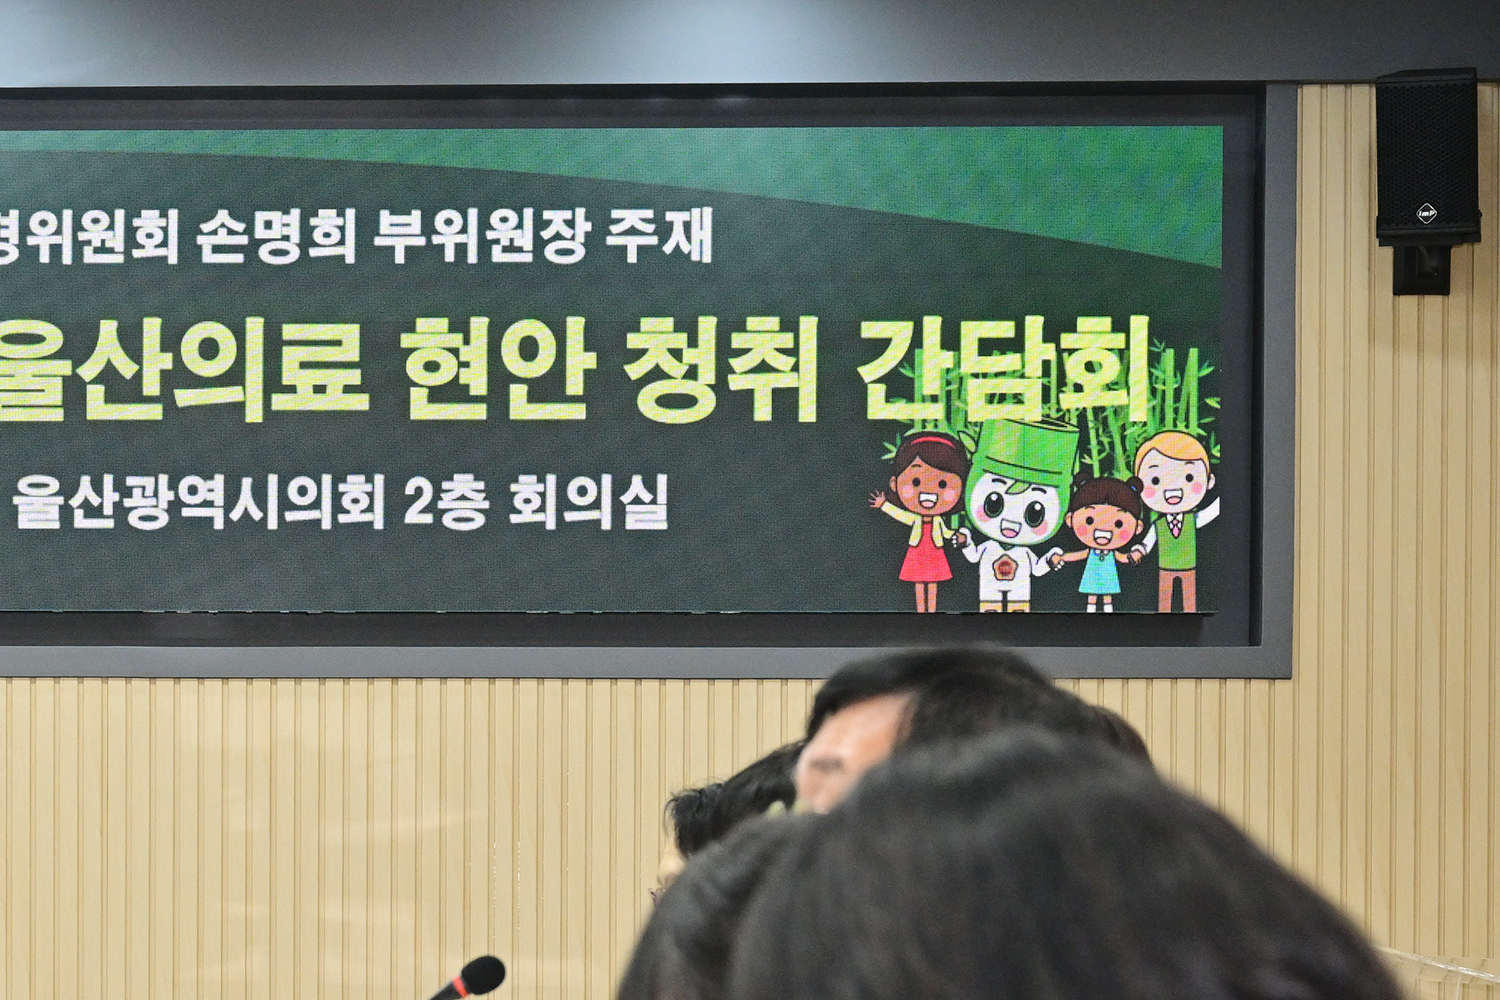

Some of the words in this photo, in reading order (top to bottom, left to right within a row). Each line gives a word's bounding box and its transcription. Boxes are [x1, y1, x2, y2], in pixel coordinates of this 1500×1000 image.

[197, 207, 356, 265] 손명희
[374, 207, 591, 265] 부위원장
[606, 206, 713, 264] 주재
[400, 316, 597, 421] 현안
[623, 315, 819, 424] 청취
[856, 315, 1152, 423] 간담회
[12, 473, 385, 531] 울산광역시의회
[404, 473, 490, 531] 2층
[509, 473, 668, 531] 회의실
